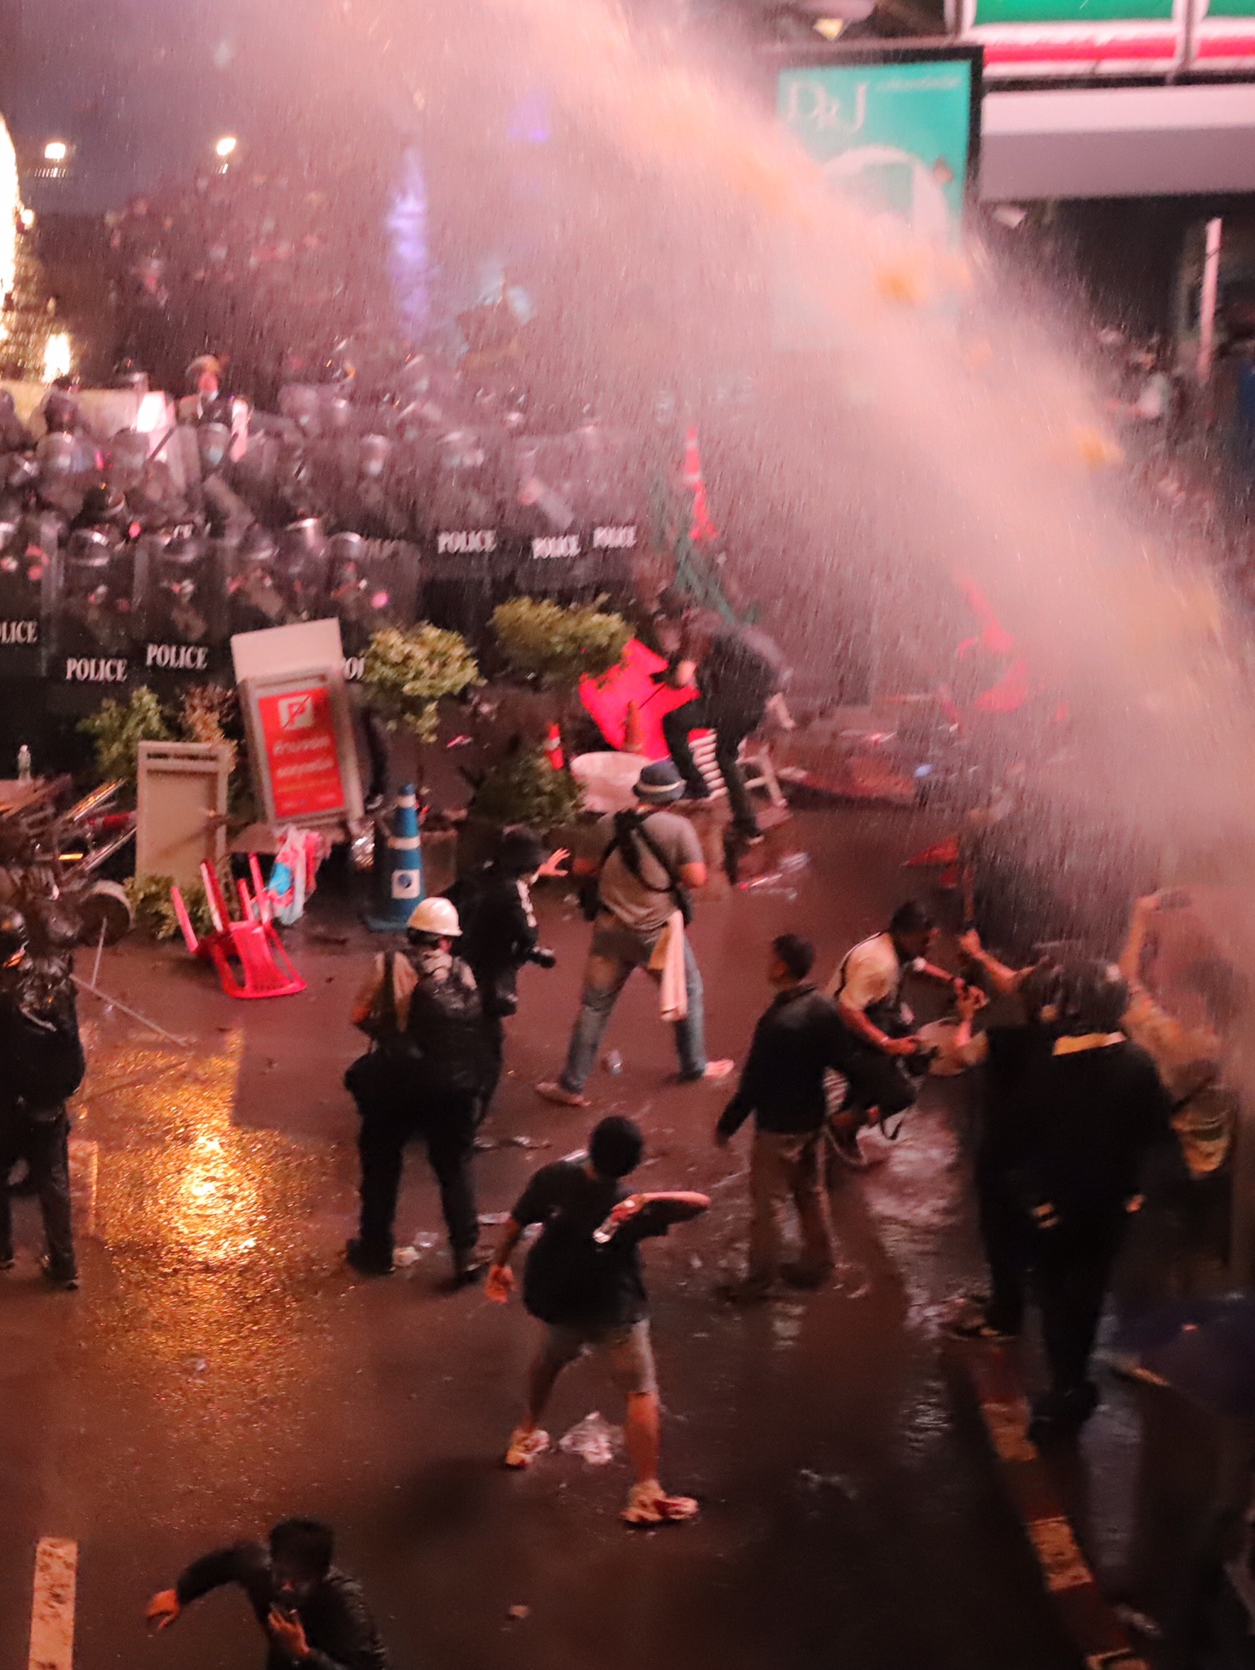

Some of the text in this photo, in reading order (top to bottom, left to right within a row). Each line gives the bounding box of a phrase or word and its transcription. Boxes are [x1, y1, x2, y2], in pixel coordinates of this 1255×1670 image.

[438, 530, 496, 553] POLICE
[146, 643, 208, 669] POLICE
[66, 657, 128, 681] POLICE
